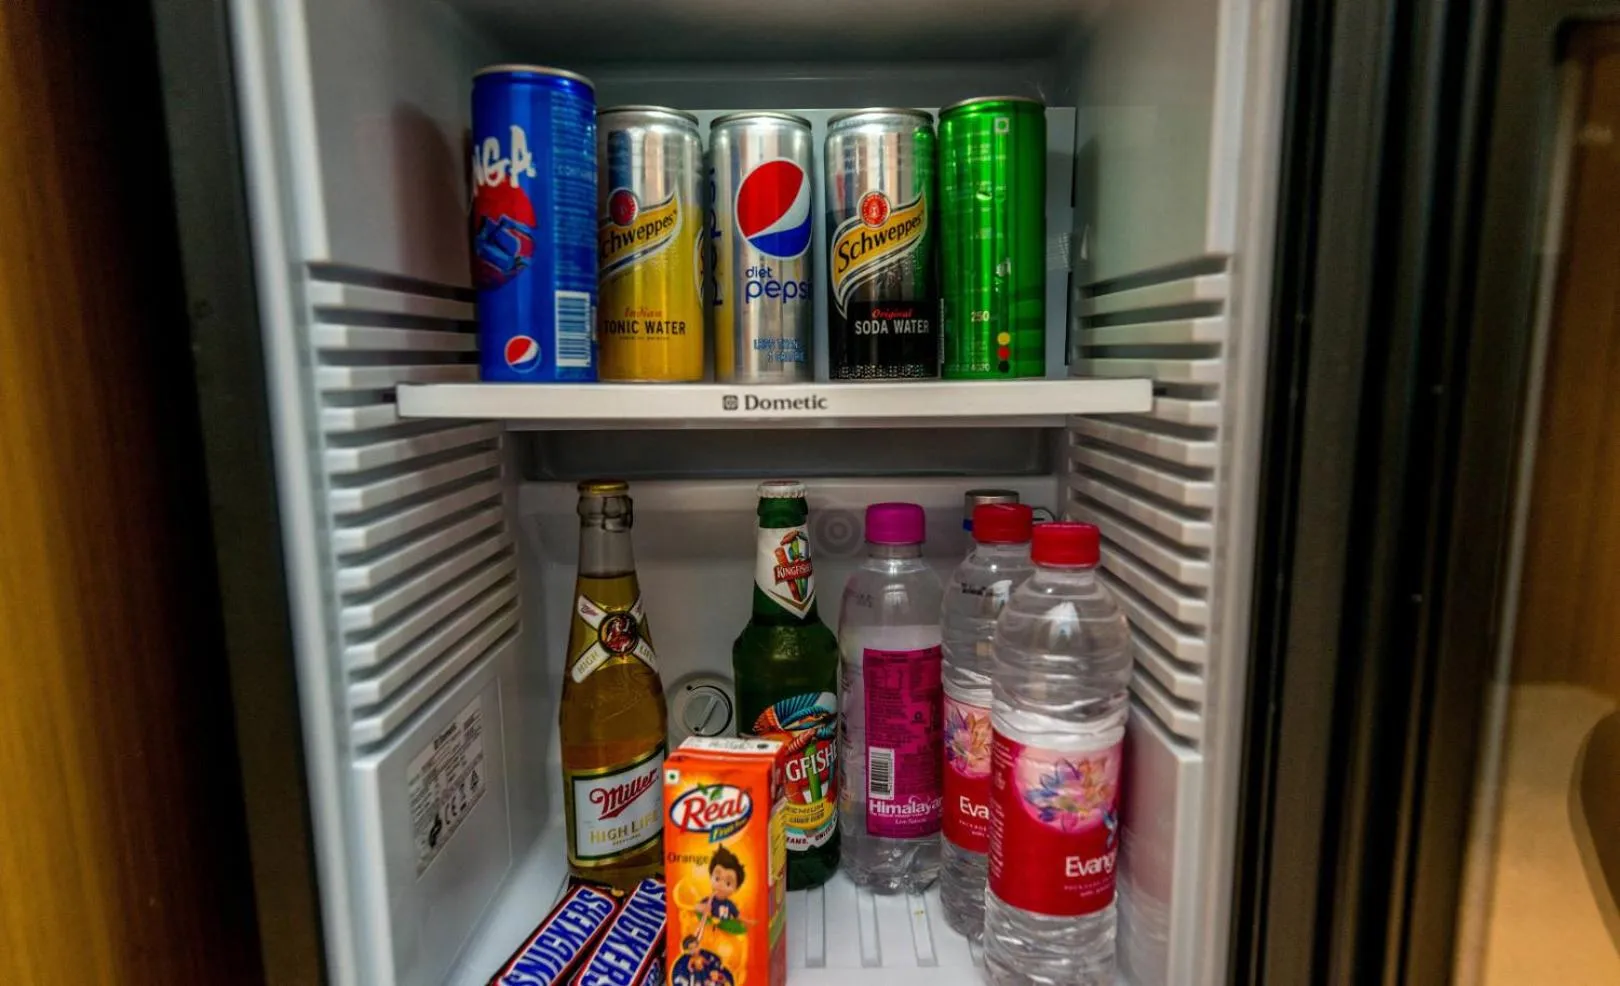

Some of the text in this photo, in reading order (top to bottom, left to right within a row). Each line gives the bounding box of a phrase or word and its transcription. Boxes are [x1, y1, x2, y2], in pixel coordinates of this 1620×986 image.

[600, 213, 674, 259] chweppes
[838, 213, 922, 273] Schweppes
[745, 265, 773, 279] diet
[745, 280, 812, 305] peps
[871, 307, 913, 320] Original
[603, 320, 687, 335] TONIC WATER
[855, 319, 930, 335] SODA WATER
[744, 394, 829, 411] Dometic
[589, 767, 660, 821] Miller
[680, 789, 744, 833] Real
[590, 824, 628, 845] HIGH
[631, 809, 659, 833] LIFE
[666, 851, 709, 867] Orange
